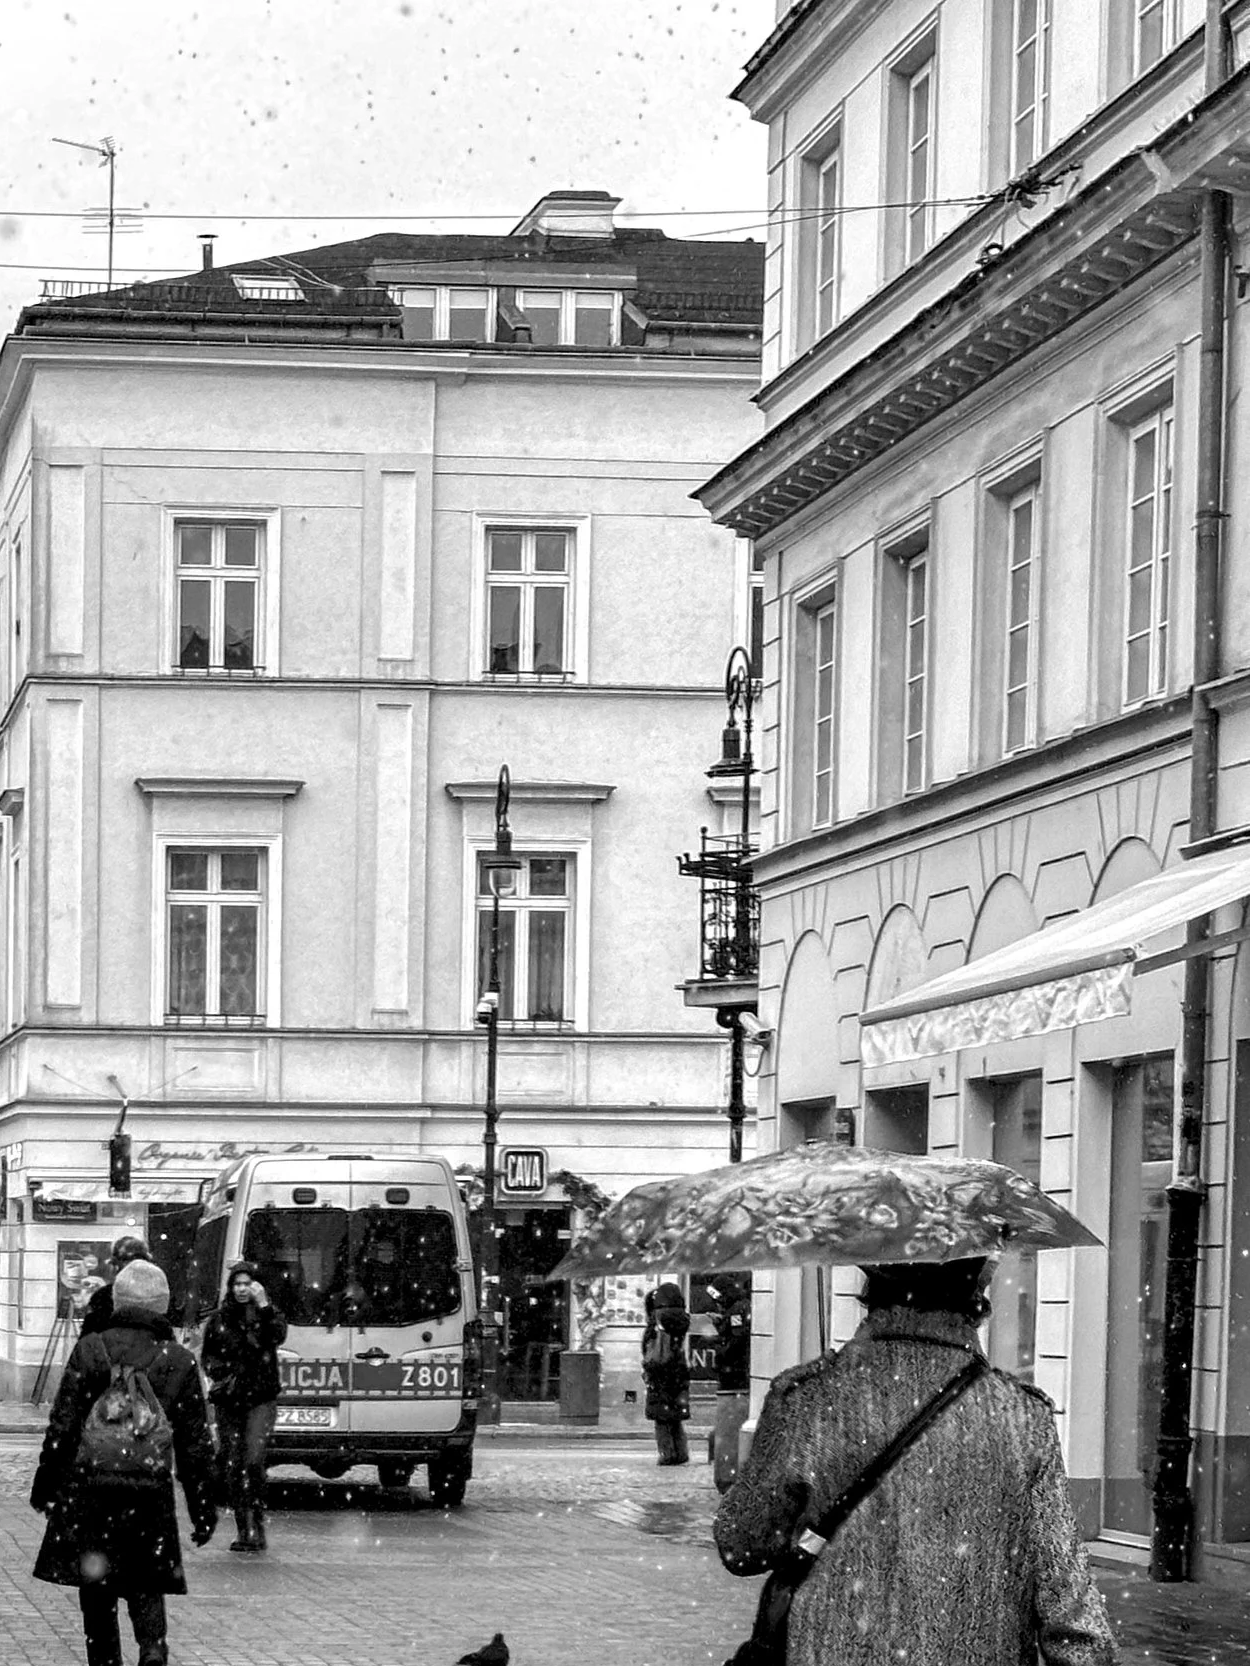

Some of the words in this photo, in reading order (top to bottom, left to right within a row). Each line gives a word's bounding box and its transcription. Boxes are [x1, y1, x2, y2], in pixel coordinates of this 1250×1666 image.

[507, 1155, 541, 1187] CAVA
[278, 1366, 343, 1387] LICJA
[401, 1366, 459, 1387] Z801
